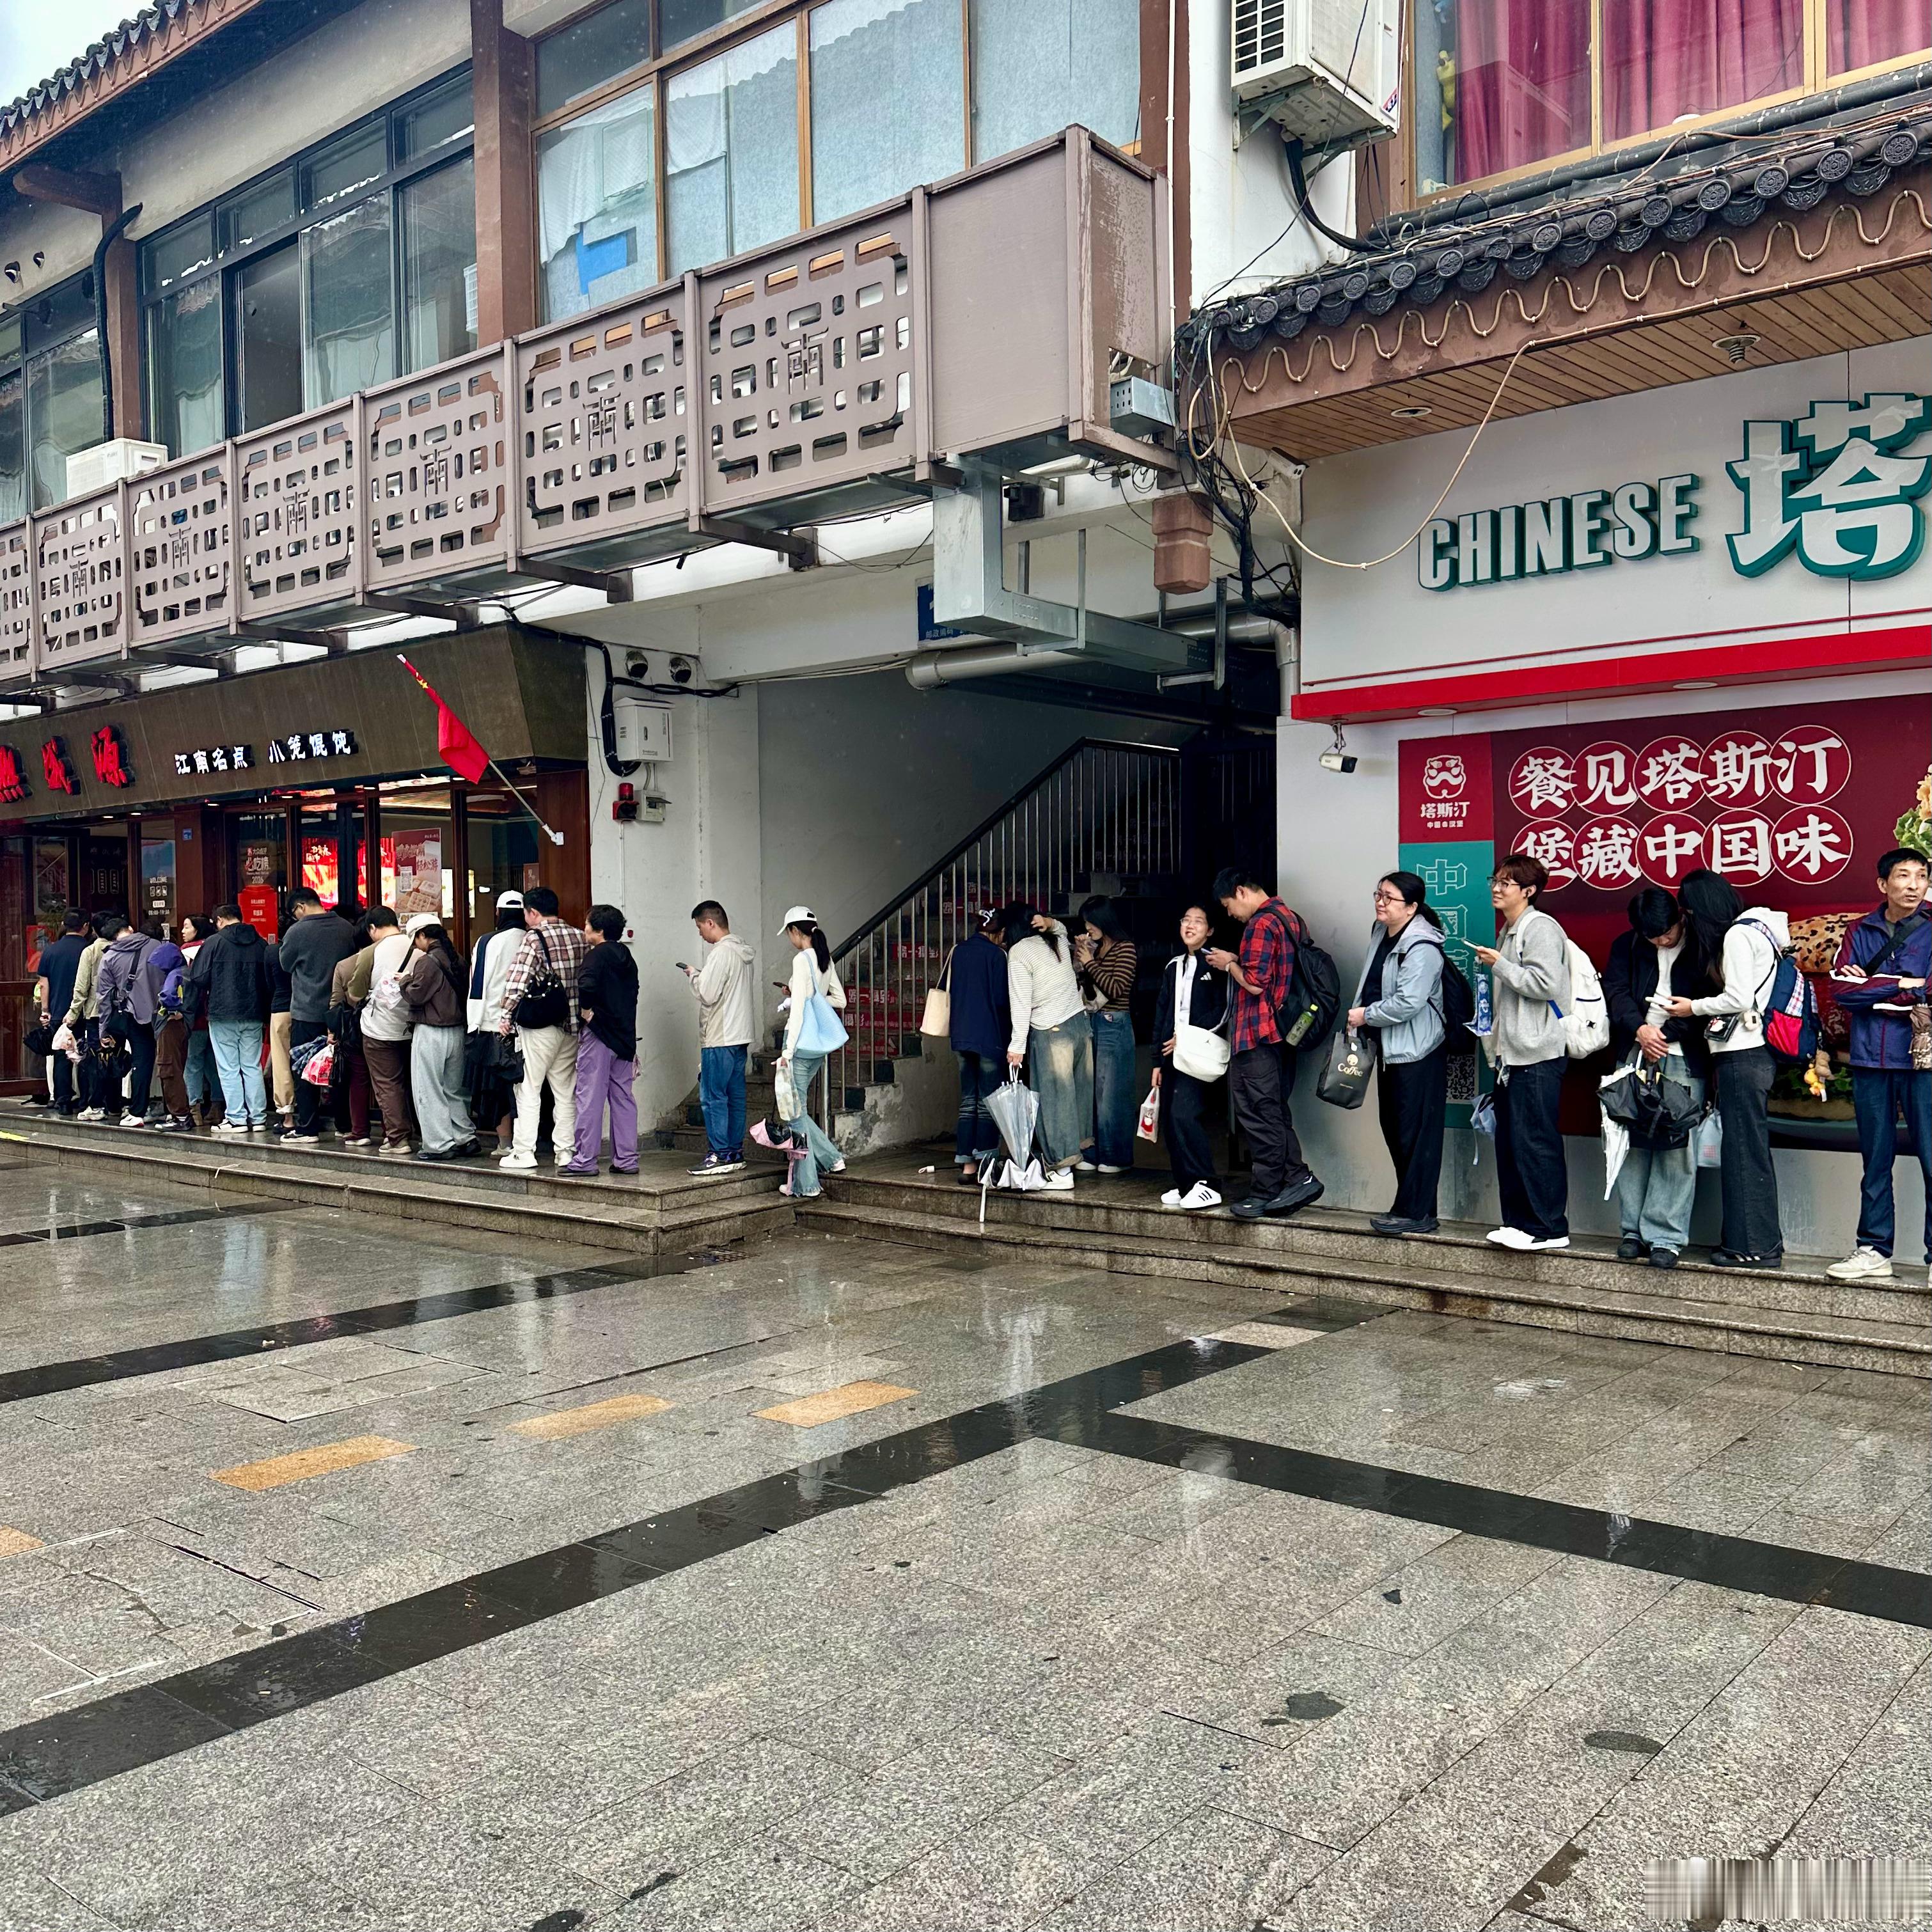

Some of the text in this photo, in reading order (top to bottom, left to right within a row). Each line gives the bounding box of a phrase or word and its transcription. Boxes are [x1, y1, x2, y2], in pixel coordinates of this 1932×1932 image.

[1418, 392, 1932, 592] CHINESE 塔
[174, 730, 352, 775] 江南名点 小笼馄饨
[1512, 736, 1842, 811] 餐见塔斯汀
[1420, 801, 1471, 819] 塔斯汀
[1513, 813, 1850, 882] 堡藏中国味
[1337, 1062, 1363, 1077] Coffee
